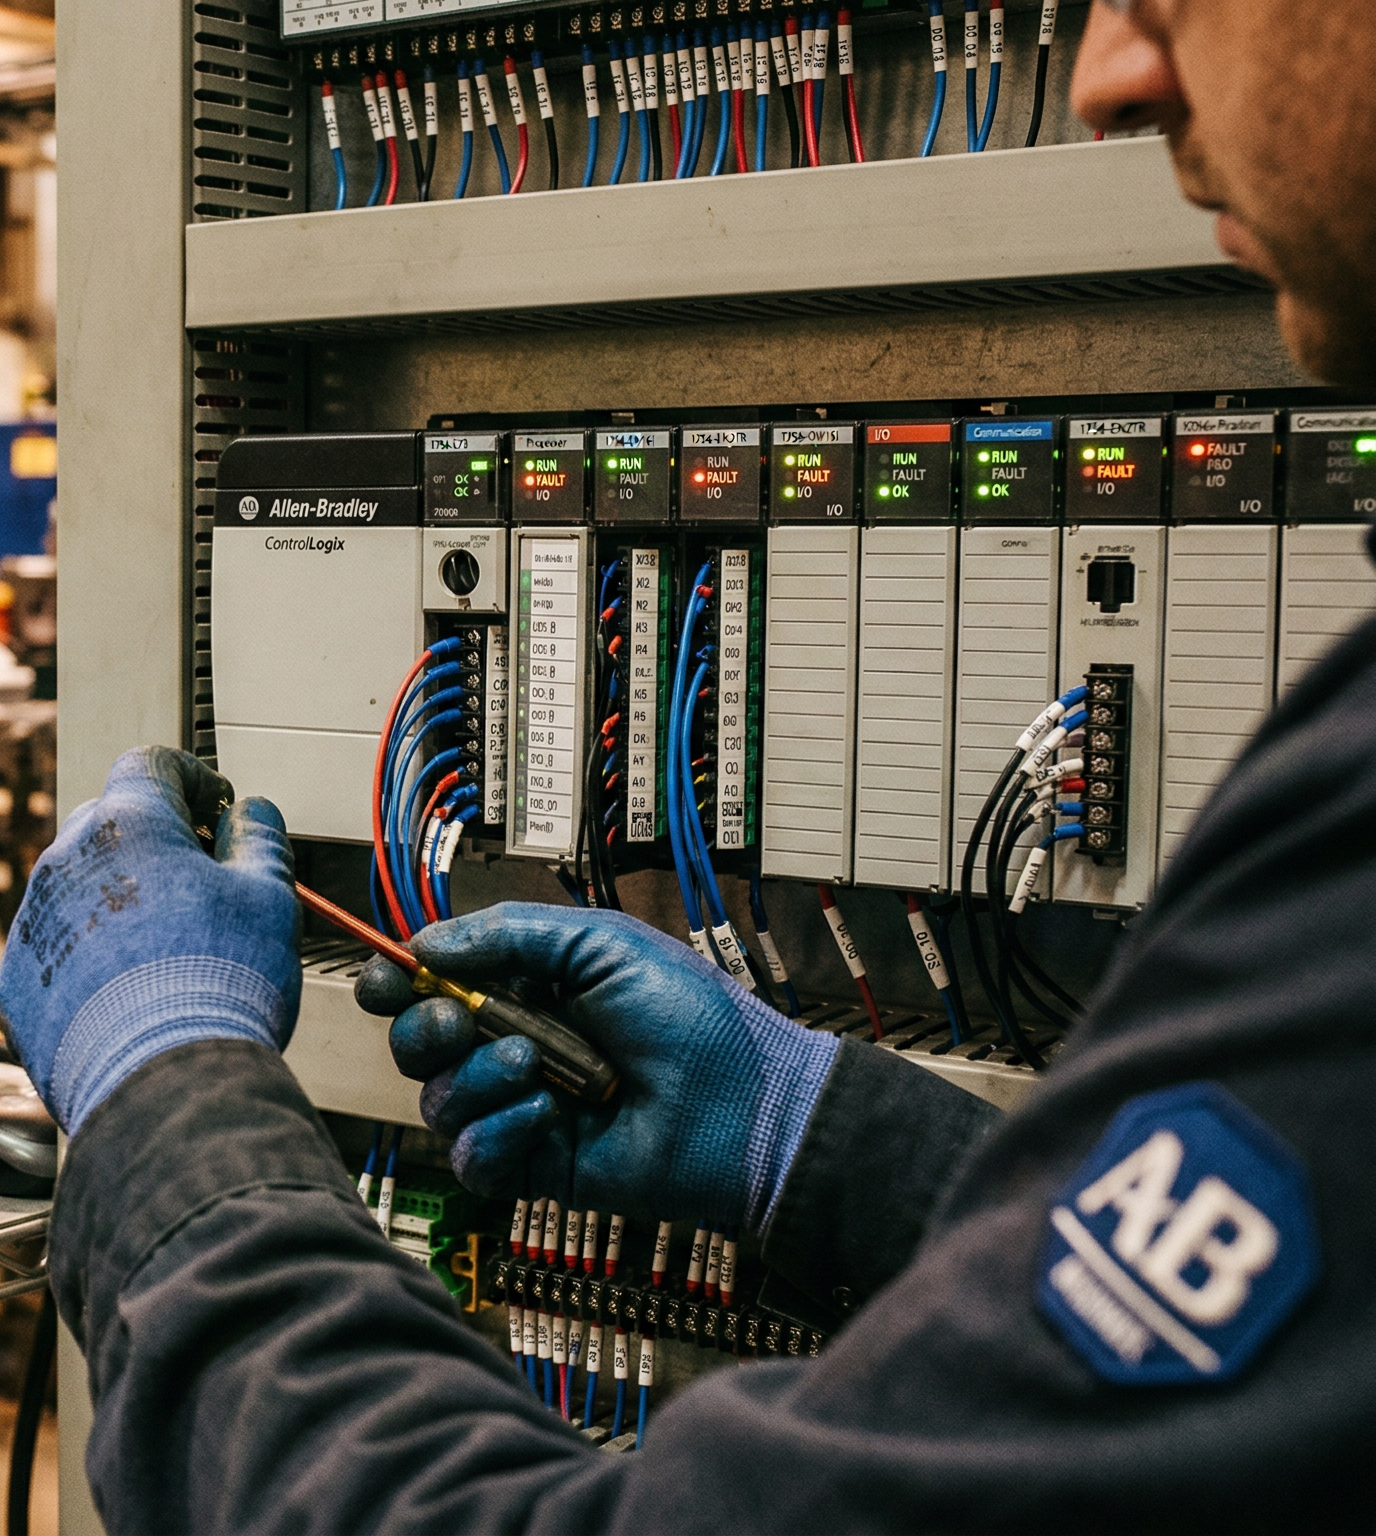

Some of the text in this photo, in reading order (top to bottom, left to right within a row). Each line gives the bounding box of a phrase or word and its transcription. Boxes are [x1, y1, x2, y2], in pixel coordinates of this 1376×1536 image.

[874, 428, 891, 440] I/O
[1097, 447, 1124, 461] RUN
[1206, 442, 1247, 456] FAULT
[707, 456, 729, 468] RUN
[797, 453, 821, 467] RUN
[991, 450, 1017, 463] RUN
[536, 459, 557, 472] RUN
[619, 458, 642, 470] RUN
[797, 469, 830, 482] FAULT
[991, 467, 1027, 479] FAULT
[1097, 464, 1135, 478] FAULT
[1206, 474, 1226, 487] I/O
[619, 489, 634, 500] I/O
[707, 487, 722, 499] I/O
[797, 486, 812, 498] I/O
[892, 485, 910, 498] OK
[991, 484, 1010, 497] OK
[1097, 482, 1115, 495] I/O
[536, 490, 550, 501] I/O
[269, 499, 379, 522] Allen-Bradley
[826, 504, 843, 516] I/O
[1239, 499, 1262, 513] I/O
[264, 536, 346, 554] ControlLogix
